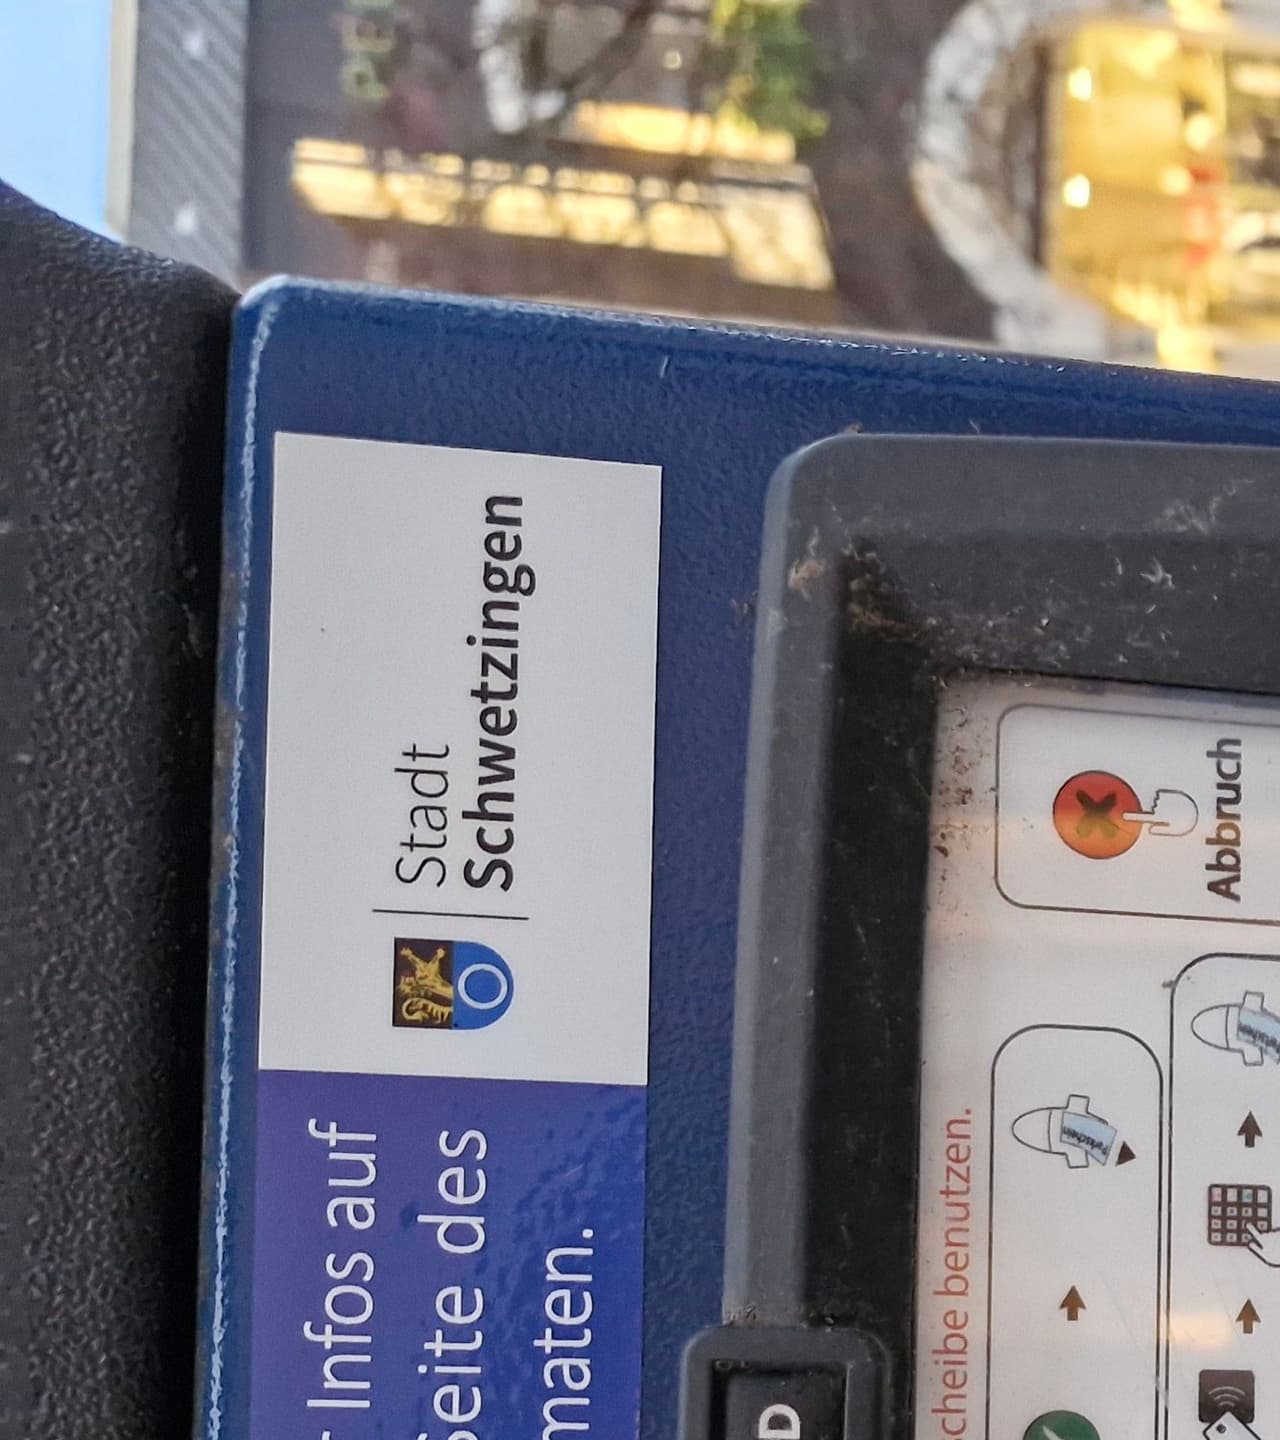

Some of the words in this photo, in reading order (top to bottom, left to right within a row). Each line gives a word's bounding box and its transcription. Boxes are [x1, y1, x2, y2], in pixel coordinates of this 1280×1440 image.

[462, 494, 536, 891] Schwetzingen
[396, 745, 450, 888] Stadt
[1206, 738, 1244, 902] Abbruch
[309, 1119, 379, 1230] auf
[423, 1128, 489, 1253] des
[934, 1108, 972, 1297] benutzen.
[304, 1251, 377, 1408] Infos
